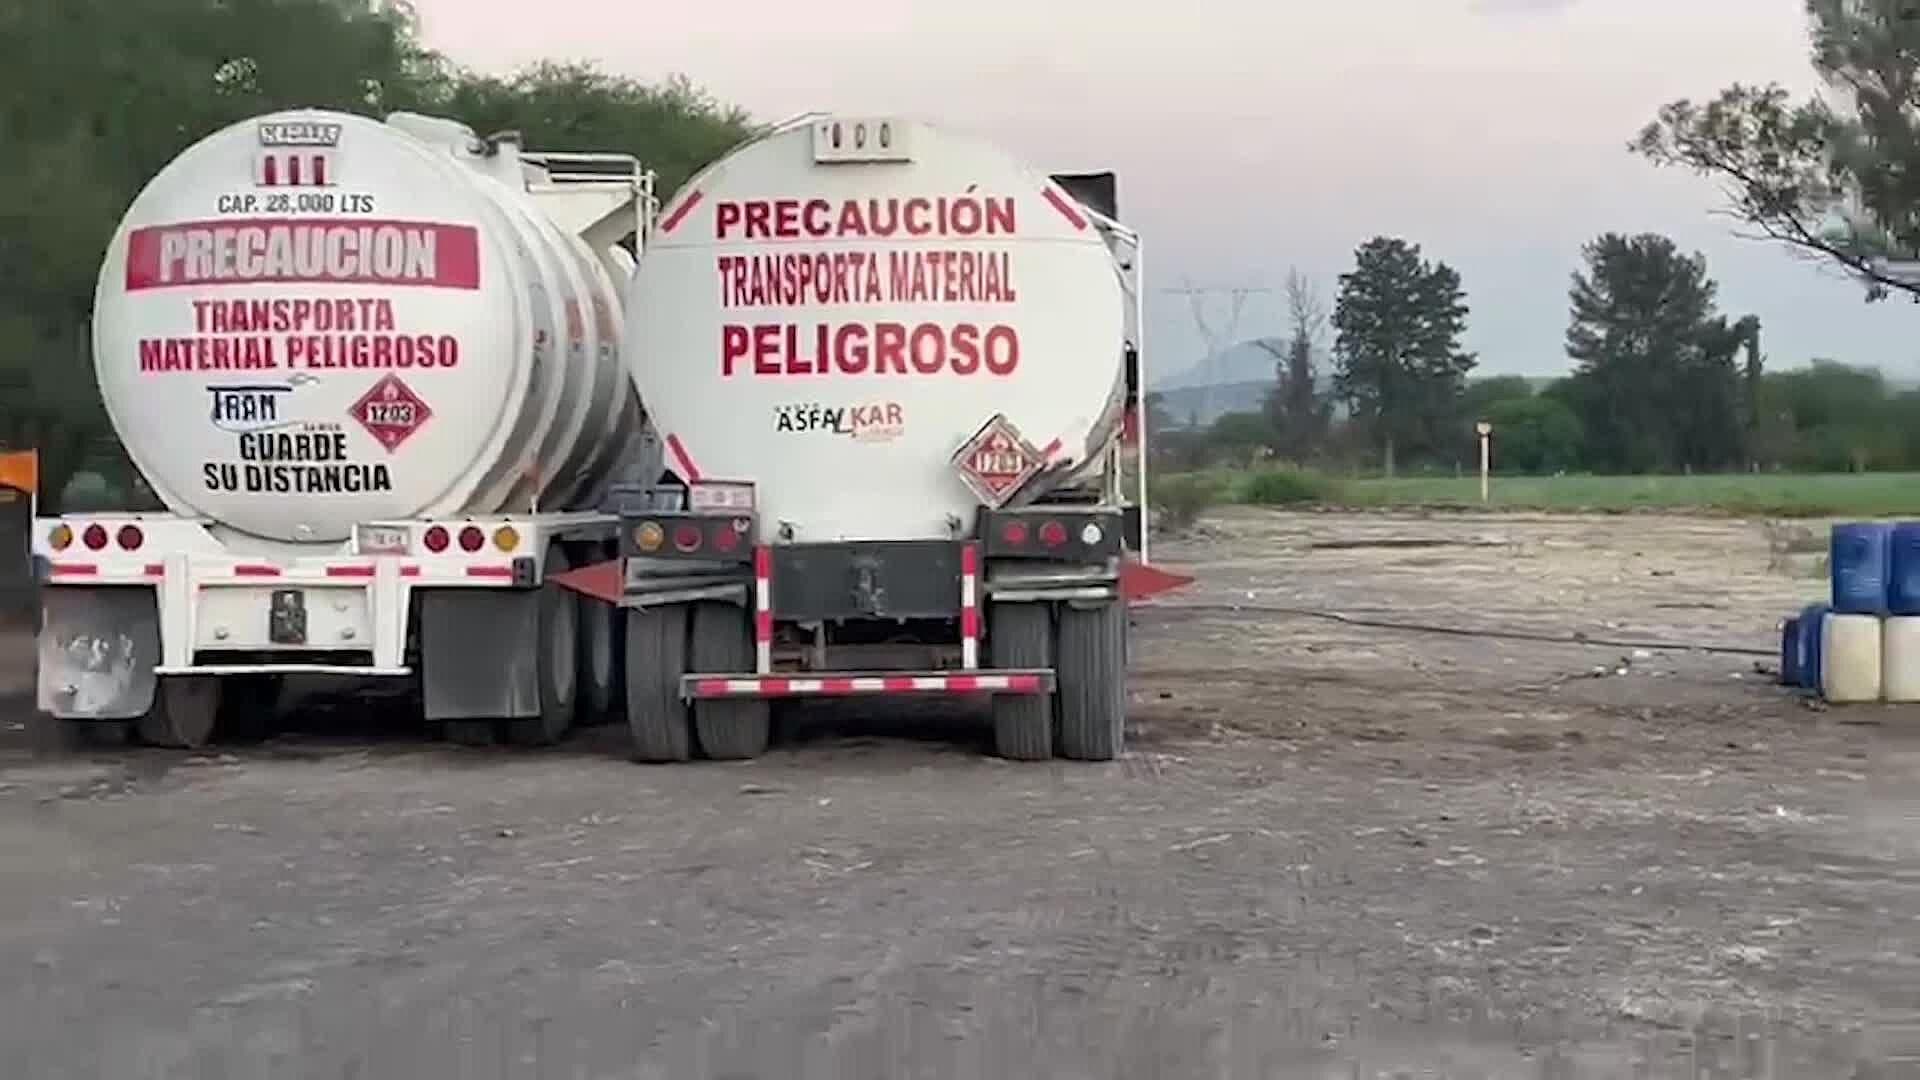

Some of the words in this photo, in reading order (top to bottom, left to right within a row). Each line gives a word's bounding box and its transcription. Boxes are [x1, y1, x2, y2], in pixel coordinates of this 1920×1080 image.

[218, 194, 258, 213] CAP.
[341, 194, 374, 213] LTS
[716, 184, 1015, 239] PRECAUCIÓN
[158, 226, 437, 281] PRECAUCION
[719, 251, 882, 307] TRANSPORTA
[889, 250, 1016, 303] MATERIAL
[193, 299, 395, 332] TRANSPORTA
[139, 336, 276, 370] MATERIAL
[287, 335, 458, 369] PELIGROSO
[722, 322, 1020, 376] PELIGROSO
[240, 433, 347, 461] GUARDE
[204, 463, 238, 491] SU
[245, 464, 392, 492] DISTANCIA
